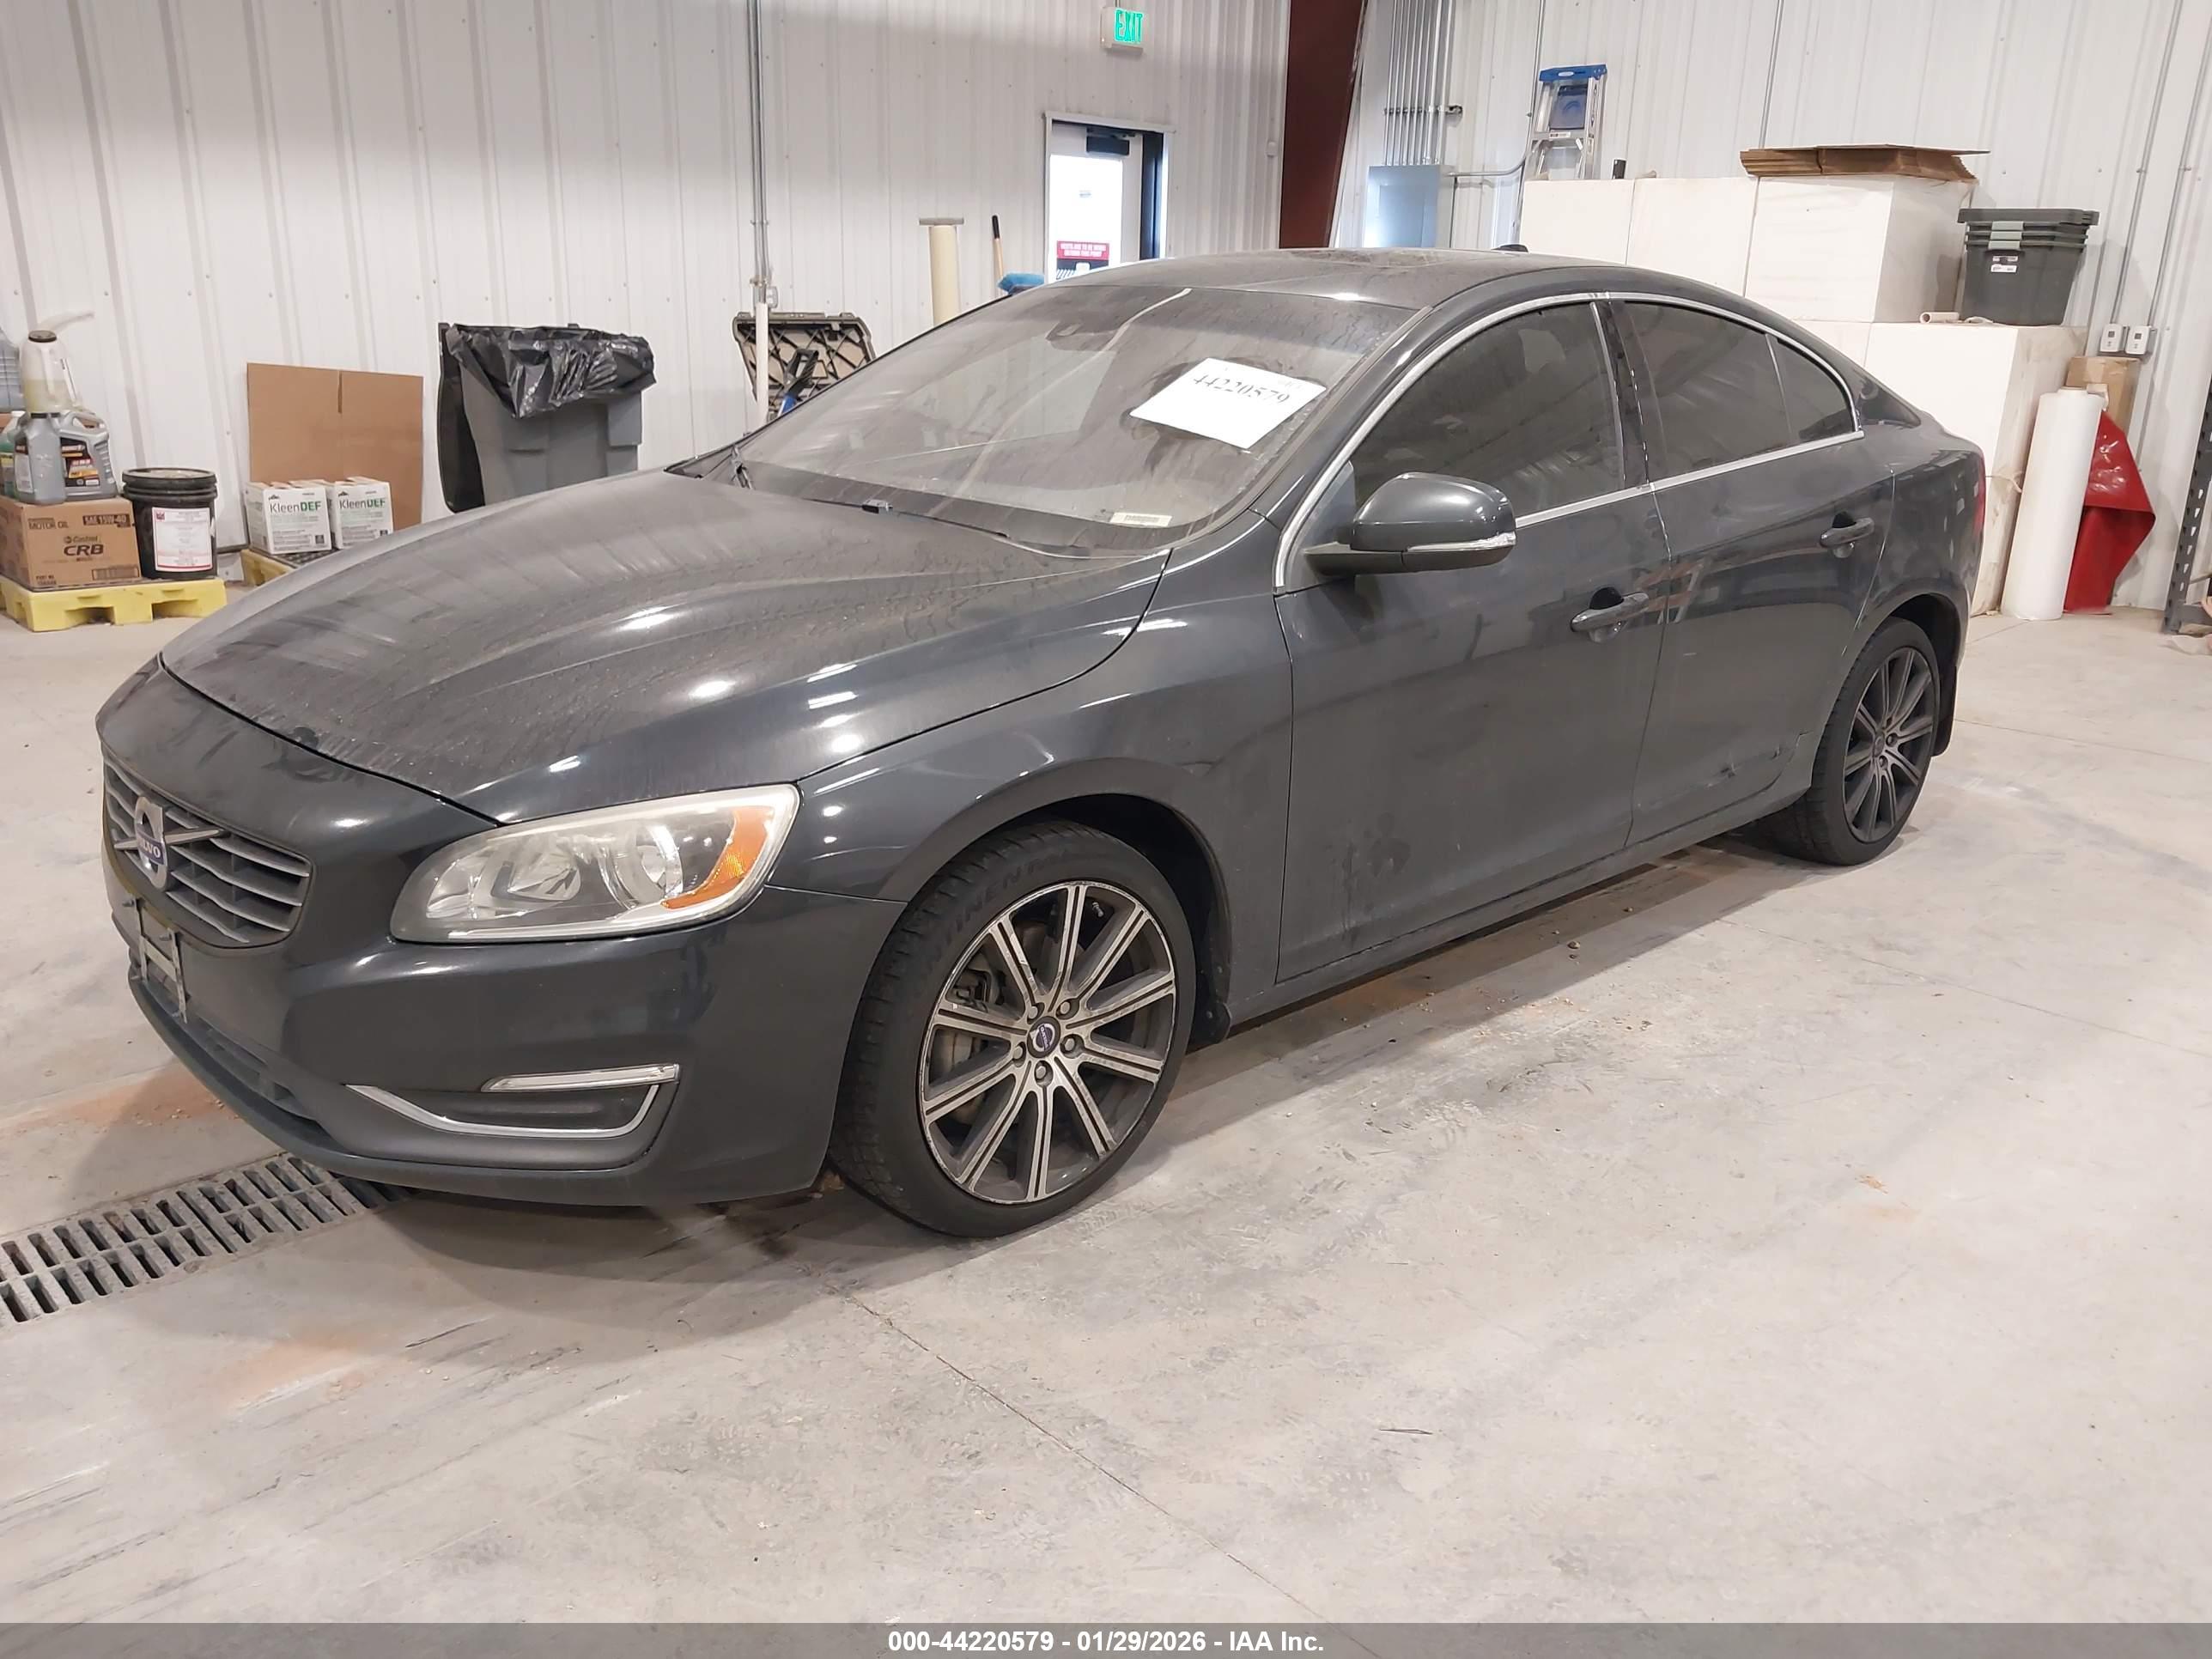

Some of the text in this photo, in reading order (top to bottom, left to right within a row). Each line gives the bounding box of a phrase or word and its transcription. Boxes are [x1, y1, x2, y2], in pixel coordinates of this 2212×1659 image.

[1115, 9, 1143, 42] EXIT
[1193, 374, 1291, 404] 44220579
[270, 501, 322, 514] KleenDEF
[338, 497, 386, 509] KleenDEF
[28, 520, 70, 530] MOTOR OIL
[64, 544, 104, 556] CRB
